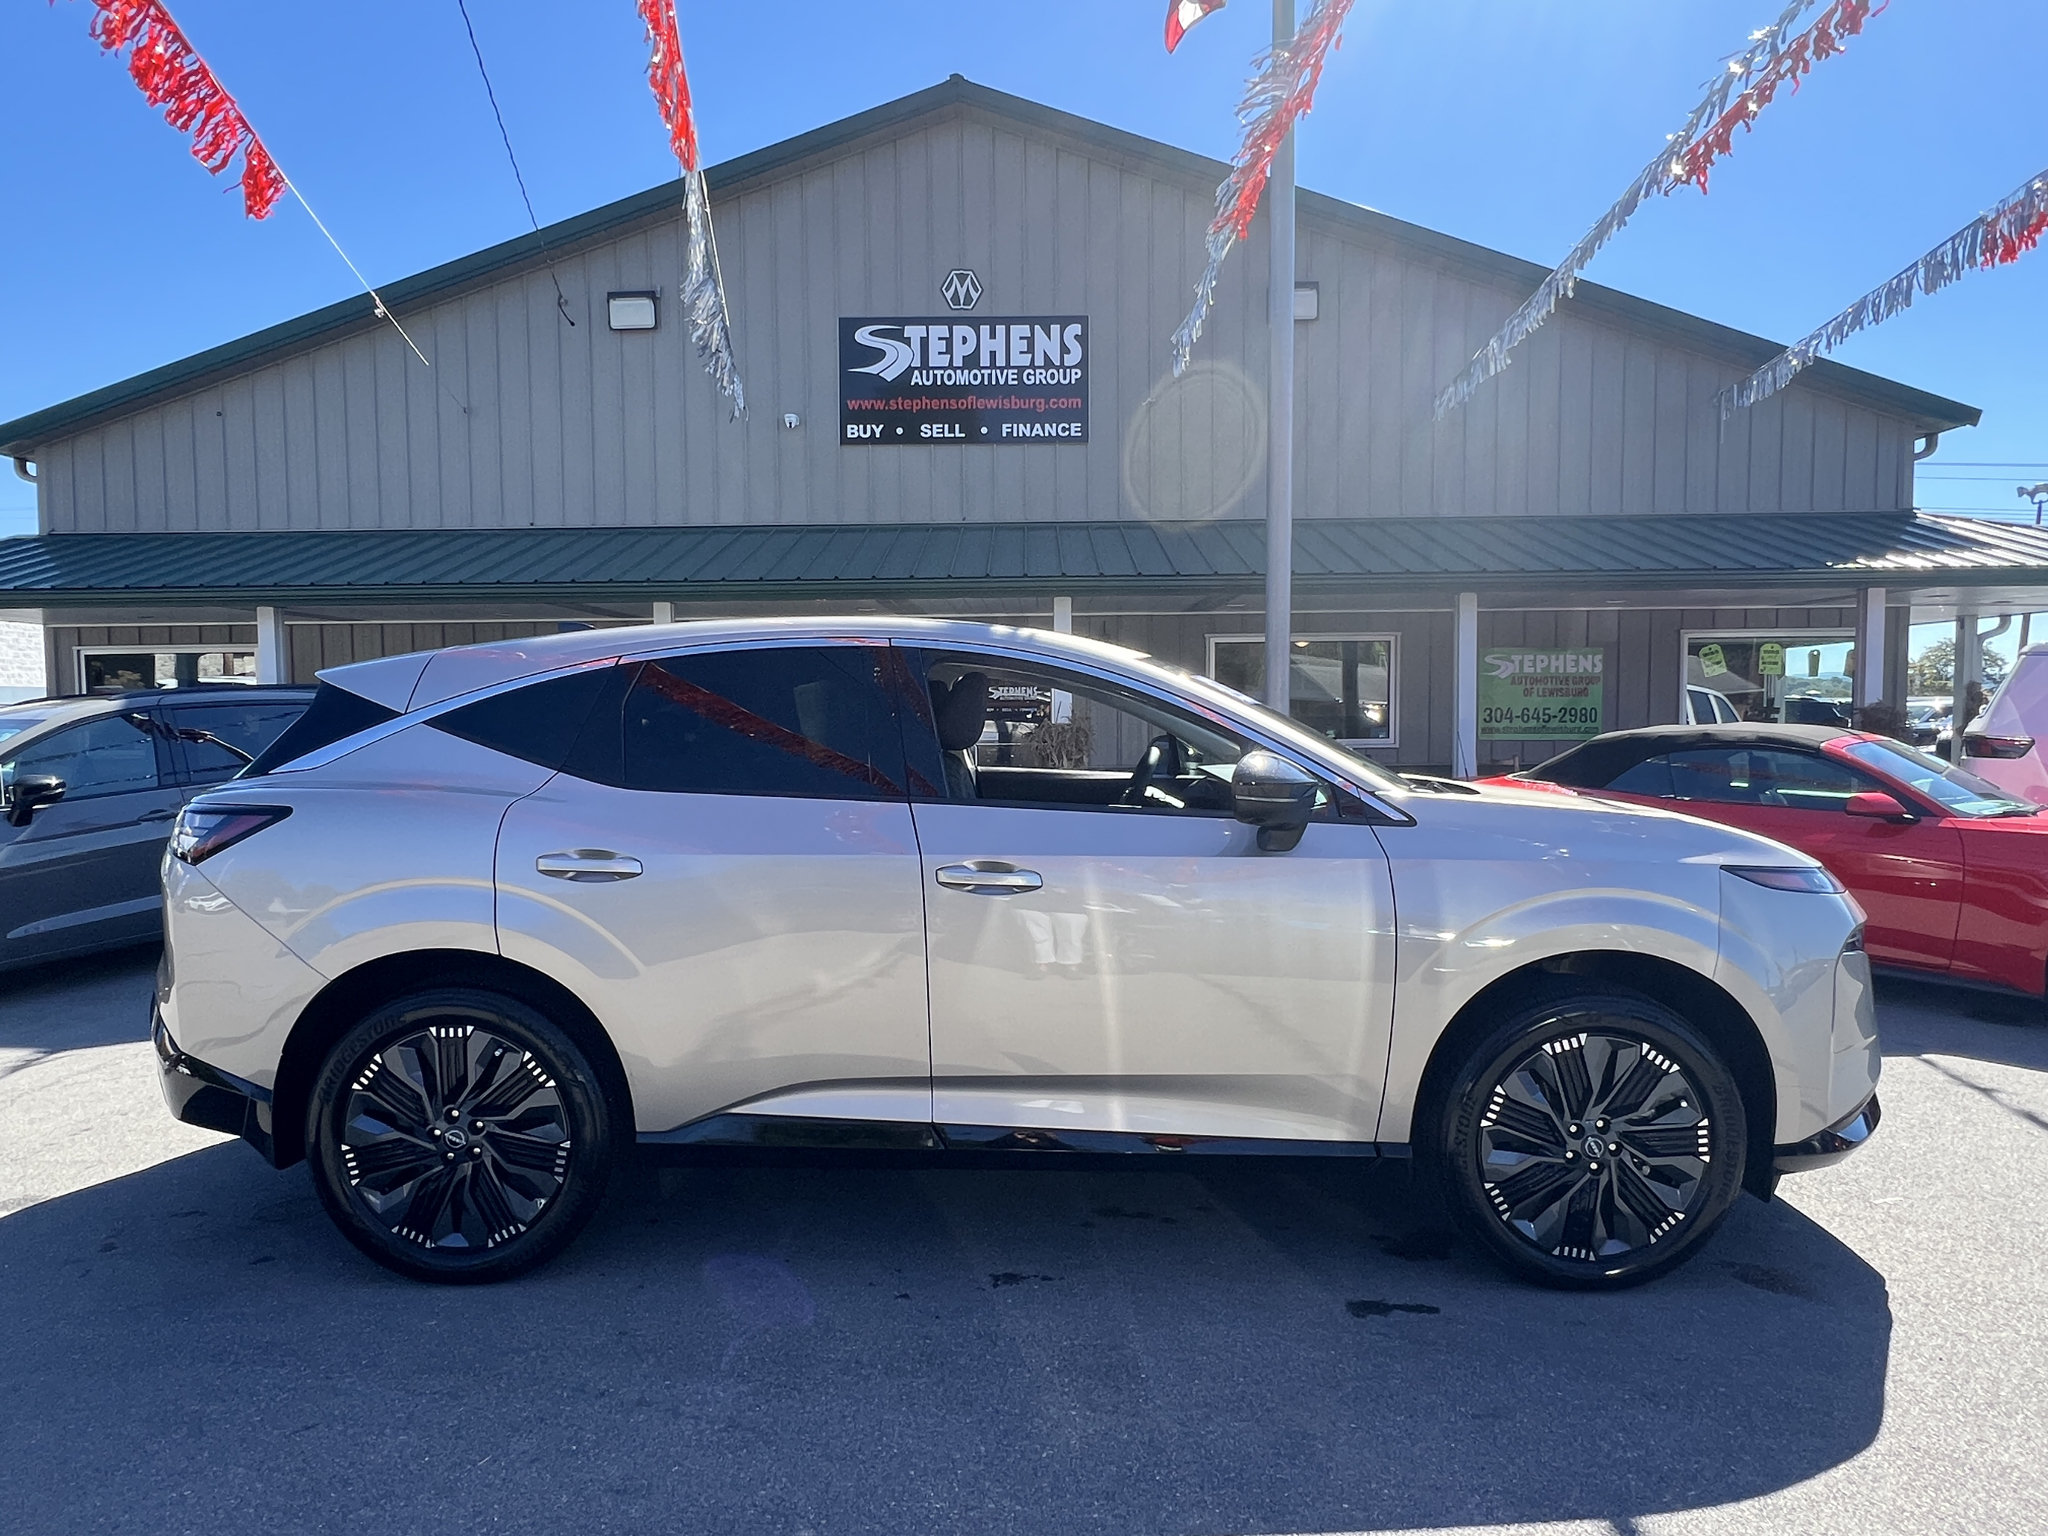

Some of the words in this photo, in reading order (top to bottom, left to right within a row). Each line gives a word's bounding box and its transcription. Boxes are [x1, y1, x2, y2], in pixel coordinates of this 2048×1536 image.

[847, 323, 1083, 382] STEPHENS
[910, 369, 1018, 386] AUTOMOTIVE
[1022, 368, 1082, 385] GROUP
[847, 395, 1082, 412] www.stephensoflewisburg.com
[846, 424, 884, 438] BUY
[920, 423, 966, 437] SELL
[1002, 422, 1082, 437] FINANCE
[1480, 653, 1603, 679] STEPHENS
[1510, 675, 1569, 686] AUTOMOTIVE
[1571, 675, 1601, 686] GROUP
[1523, 687, 1535, 697] OF
[1536, 687, 1589, 697] LEWISBURG
[1483, 706, 1598, 724] 304-645-2980
